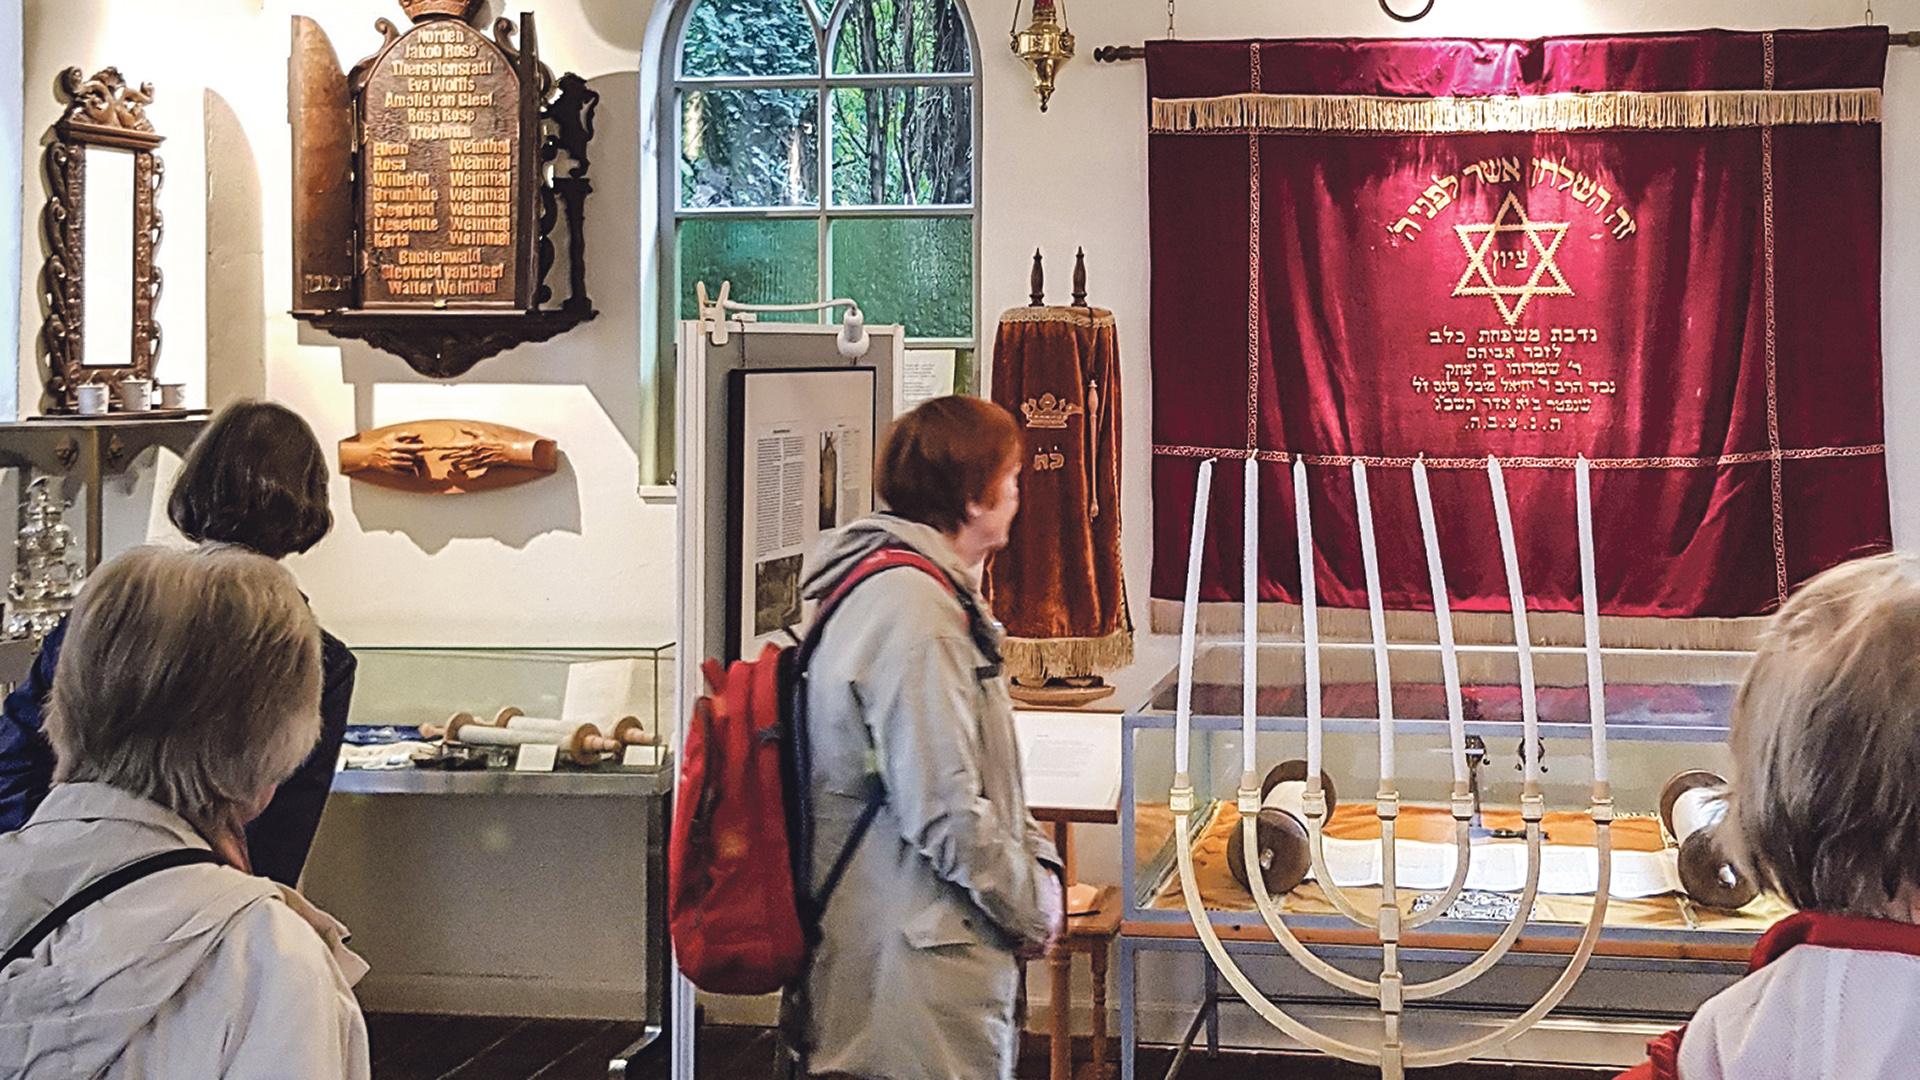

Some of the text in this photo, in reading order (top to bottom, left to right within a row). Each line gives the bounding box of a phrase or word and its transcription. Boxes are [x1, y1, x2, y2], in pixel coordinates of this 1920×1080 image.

[418, 29, 464, 43] Norden
[404, 43, 478, 59] Jakob Rose
[408, 77, 430, 92] Eva
[384, 91, 432, 108] Amalie
[432, 94, 457, 107] van
[407, 107, 475, 122] Rosa Rose
[449, 138, 511, 154] Weinthal
[373, 155, 511, 171] Rosa Weinthal
[1463, 156, 1521, 183] אשר
[373, 170, 511, 187] Wilhelm Weinthal
[1530, 156, 1611, 214] השלחן
[449, 186, 511, 201] Weinthal
[1407, 173, 1459, 219] לפני
[373, 201, 511, 218] Siegfried Weinthal
[449, 216, 511, 231] Weinthal
[1604, 206, 1636, 239] זה
[449, 230, 511, 246] Weinthal
[398, 248, 482, 264] Buchenwald
[1492, 249, 1528, 276] ציון
[381, 263, 443, 280] Siegfried
[443, 264, 469, 279] van
[387, 279, 498, 295] Walter Weinthal
[1429, 326, 1598, 344] נדבת משפחת כלב
[1466, 343, 1562, 359] לזכר אביהם
[1482, 363, 1497, 381] בן
[1554, 381, 1583, 394] הרב
[1588, 381, 1616, 394] נכד
[1482, 397, 1511, 411] אדר
